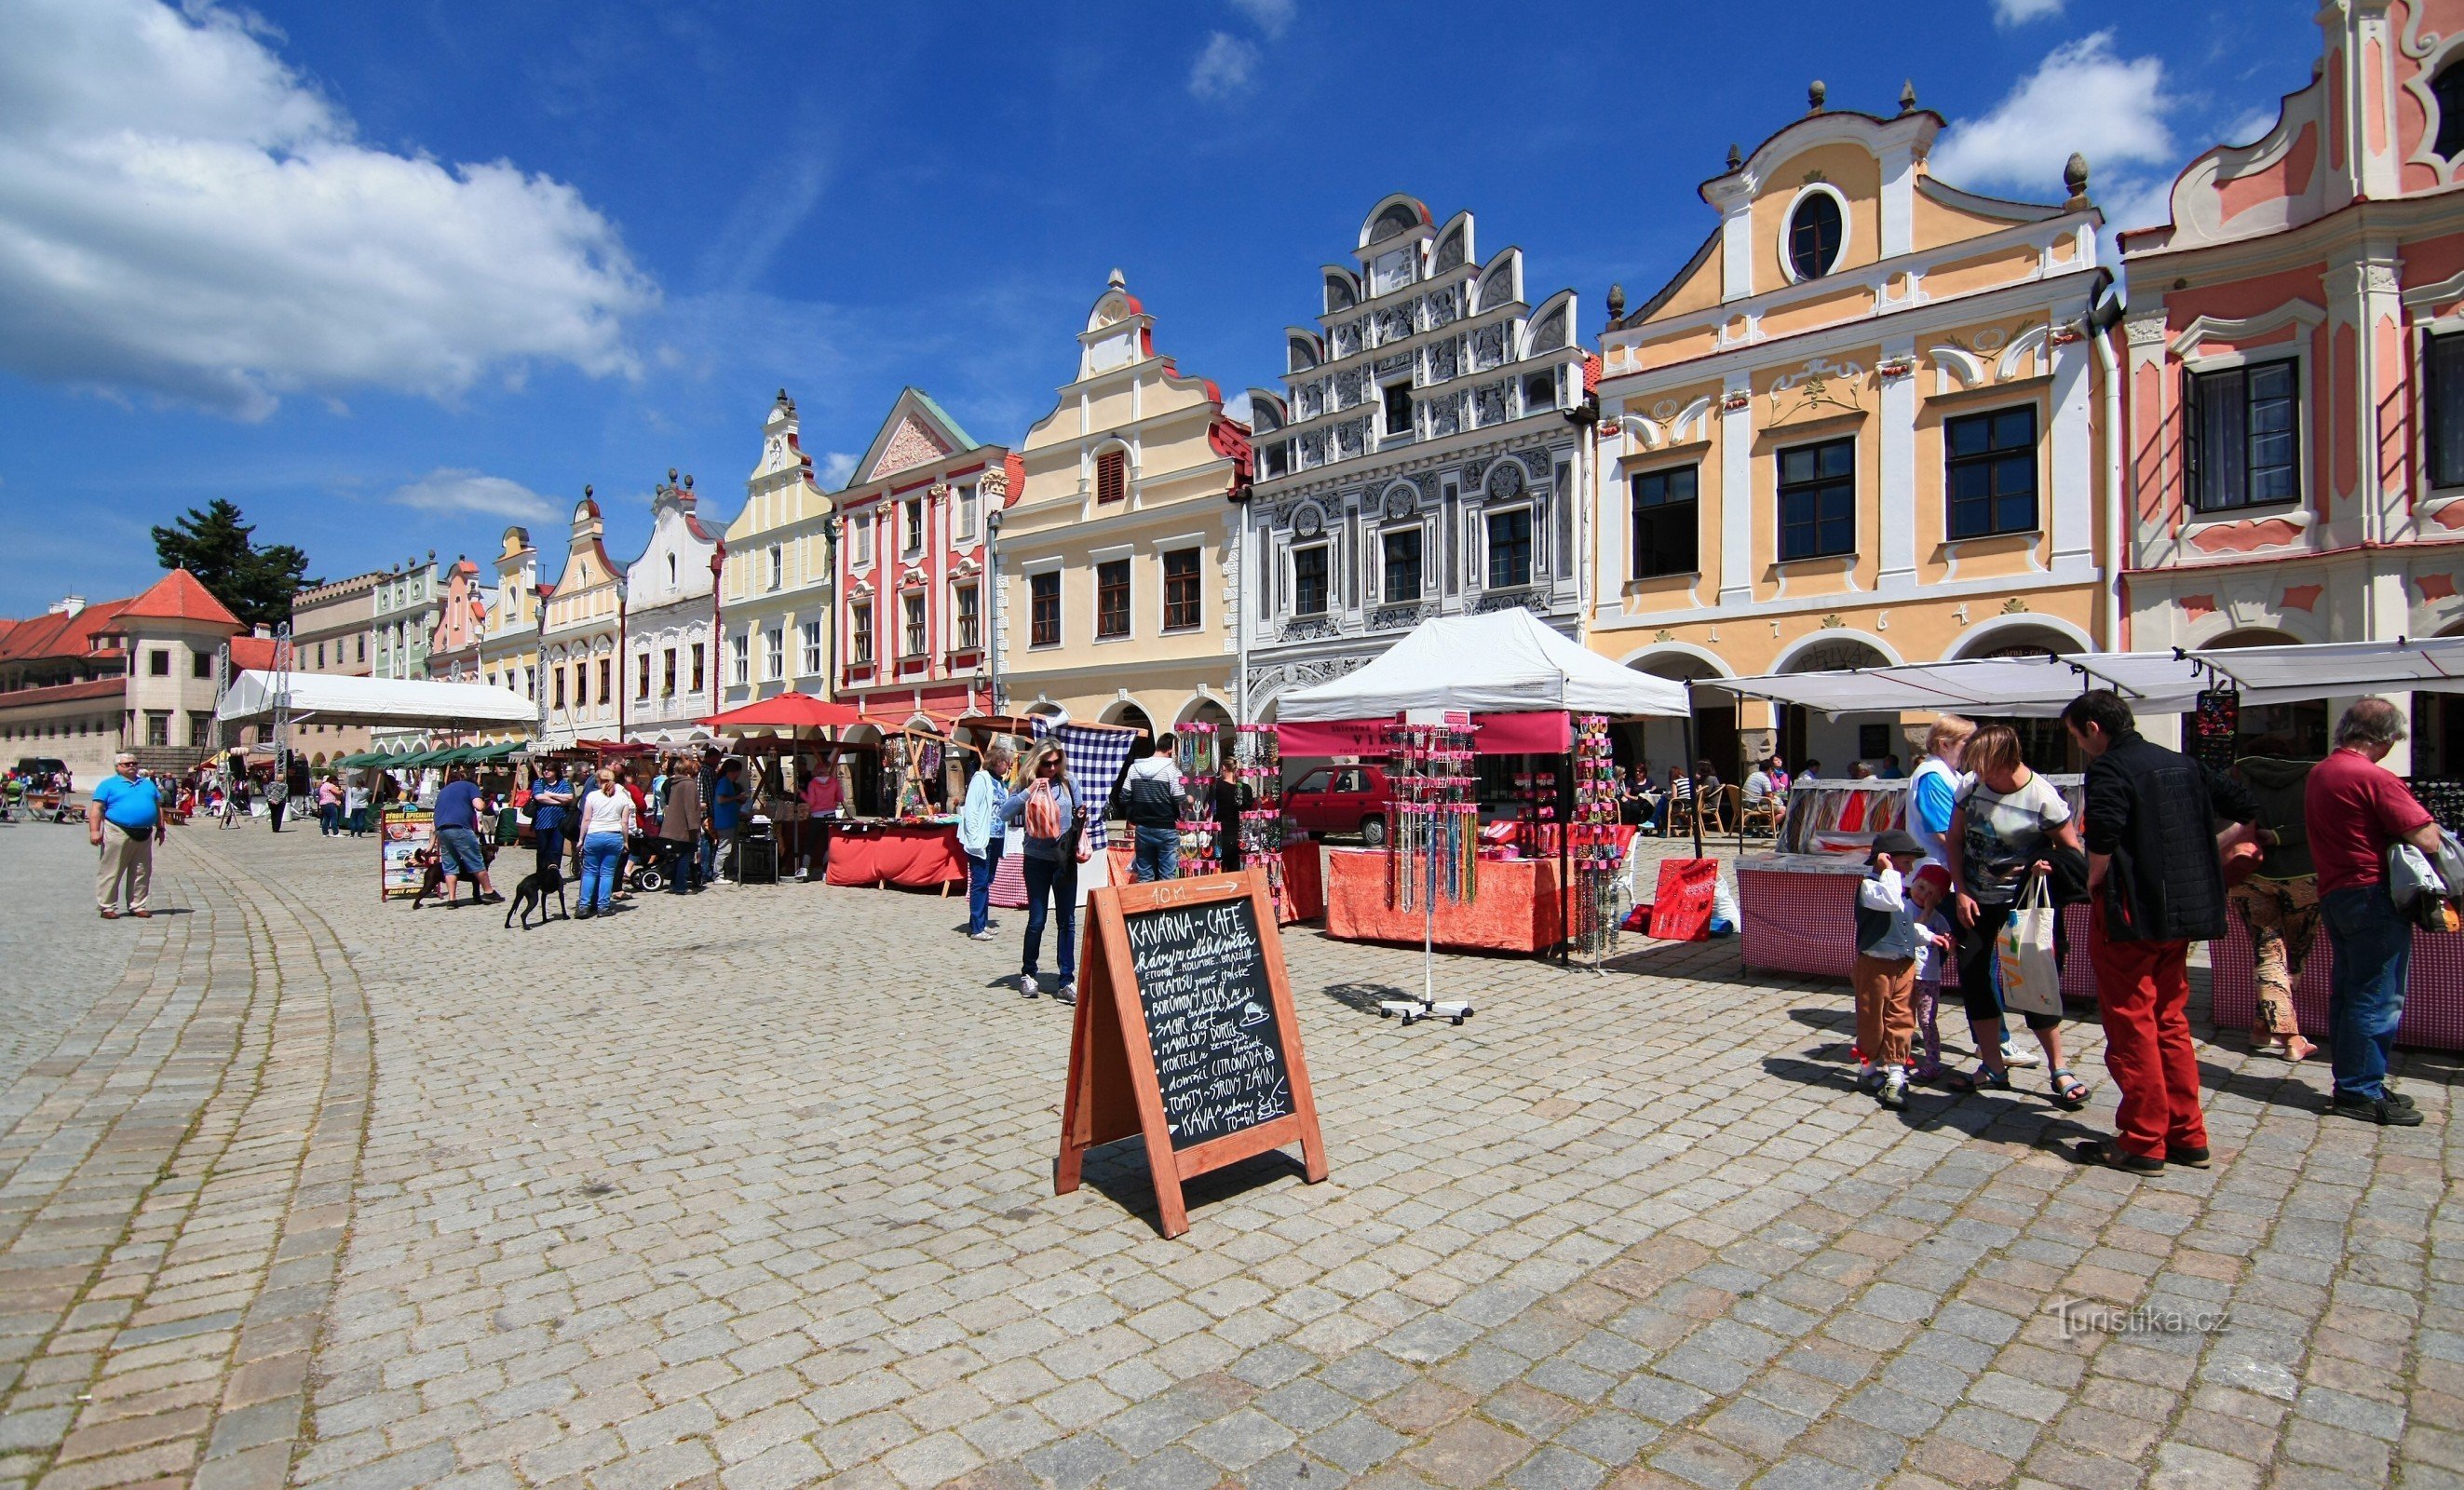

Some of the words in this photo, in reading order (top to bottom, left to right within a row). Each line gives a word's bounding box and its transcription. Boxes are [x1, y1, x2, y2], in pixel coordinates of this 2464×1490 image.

[1127, 911, 1196, 950] KAVÁRNA
[1207, 900, 1246, 936] CAFÉ
[1133, 944, 1174, 977] kávy
[1185, 928, 1221, 958] celého
[1218, 931, 1256, 956] světa
[1147, 973, 1193, 998] TIRAMISU
[1221, 962, 1254, 982] italské
[1191, 1016, 1216, 1032] dort
[1162, 1050, 1199, 1074] KOKTEJL
[1168, 1064, 1209, 1092] domácí
[1212, 1048, 1266, 1077] CITRONÁDA
[1168, 1088, 1203, 1115] TOASTY
[1209, 1070, 1241, 1101] SÝROVÝ
[1244, 1065, 1275, 1091] ZÁVIN
[1181, 1106, 1218, 1137] KÁVA
[1221, 1098, 1253, 1119] sebou
